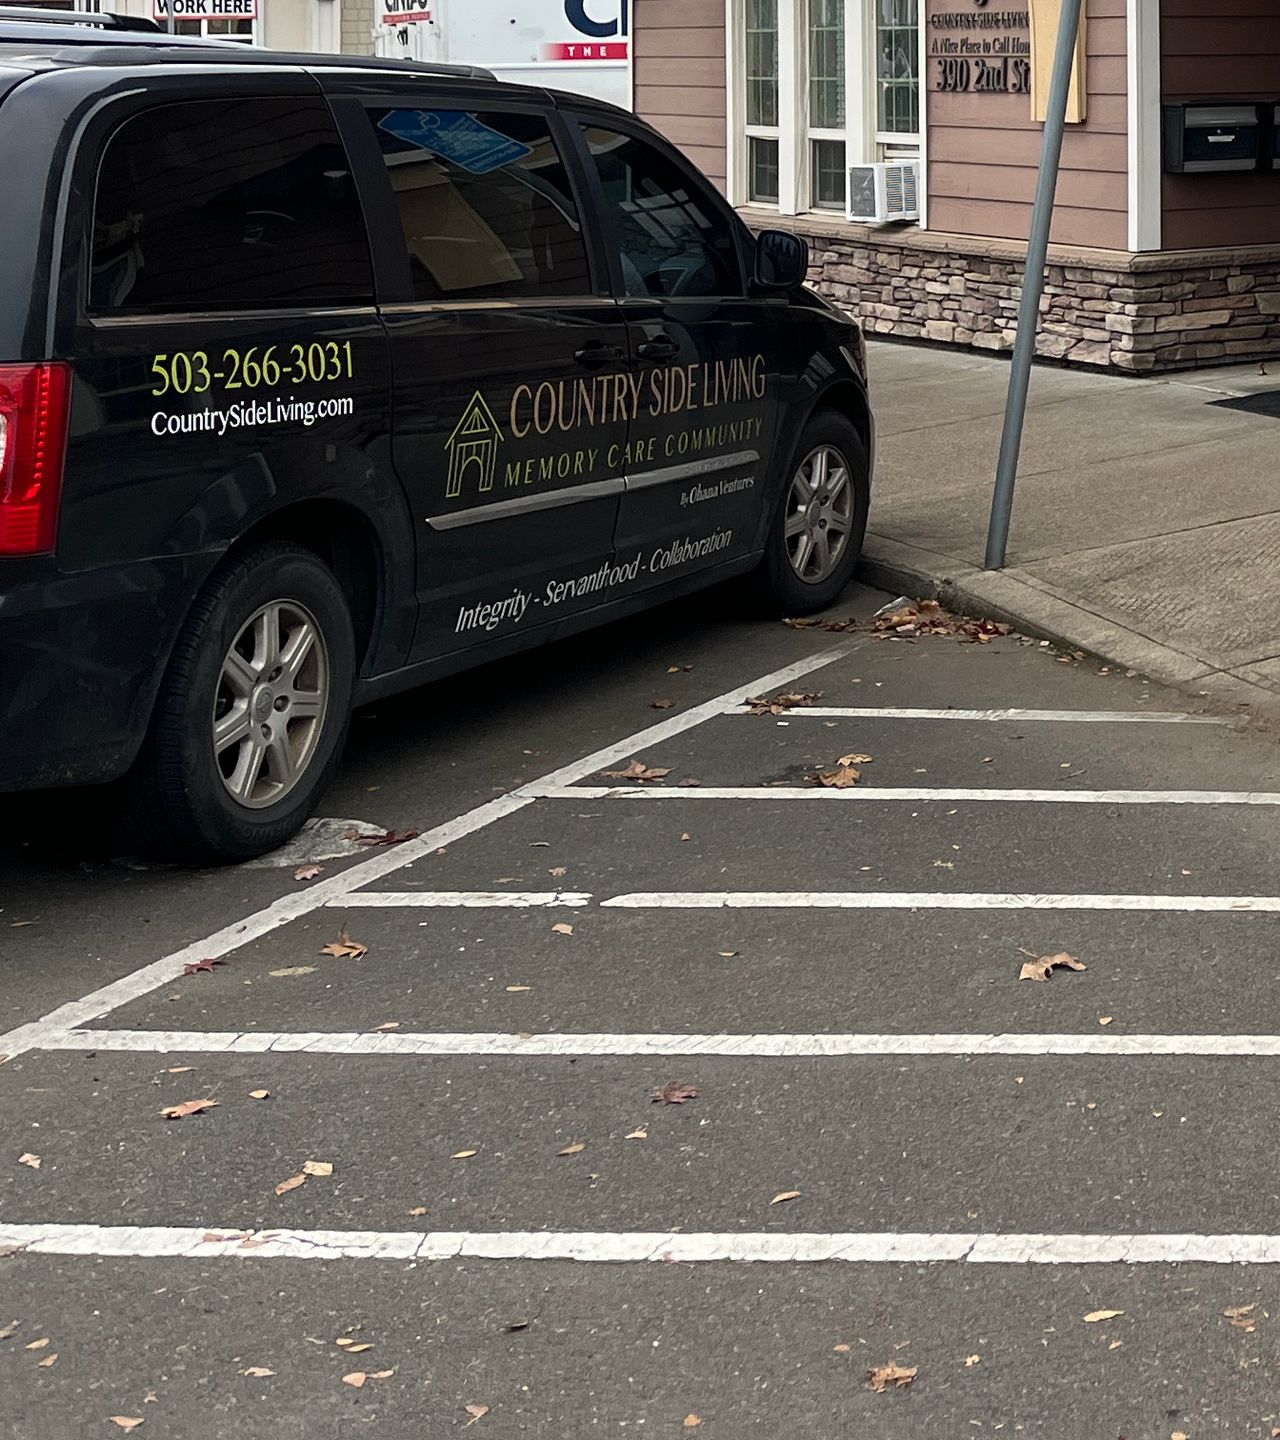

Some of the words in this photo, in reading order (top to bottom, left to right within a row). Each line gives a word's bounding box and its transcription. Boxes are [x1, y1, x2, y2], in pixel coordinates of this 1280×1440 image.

[157, 0, 207, 13] WORK
[212, 0, 252, 13] HERE
[1001, 11, 1029, 28] LIVIN
[567, 46, 607, 57] THE
[960, 37, 980, 53] Place
[992, 36, 1010, 53] Call
[936, 58, 970, 92] 390
[975, 57, 1008, 92] 2nd
[151, 340, 353, 396] 503-266-3031
[510, 370, 645, 438] COUNTRY
[650, 364, 699, 417] SIDE
[703, 354, 766, 407] LIVING
[151, 395, 353, 435] CountrySideLiving.com
[505, 448, 599, 488] MEMORY
[607, 437, 657, 468] CARE
[665, 417, 763, 456] COMMUNITY
[719, 476, 754, 499] Ventures
[454, 587, 532, 633] Integrity
[543, 552, 642, 607] Servanthood
[650, 526, 733, 573] Collaboration
